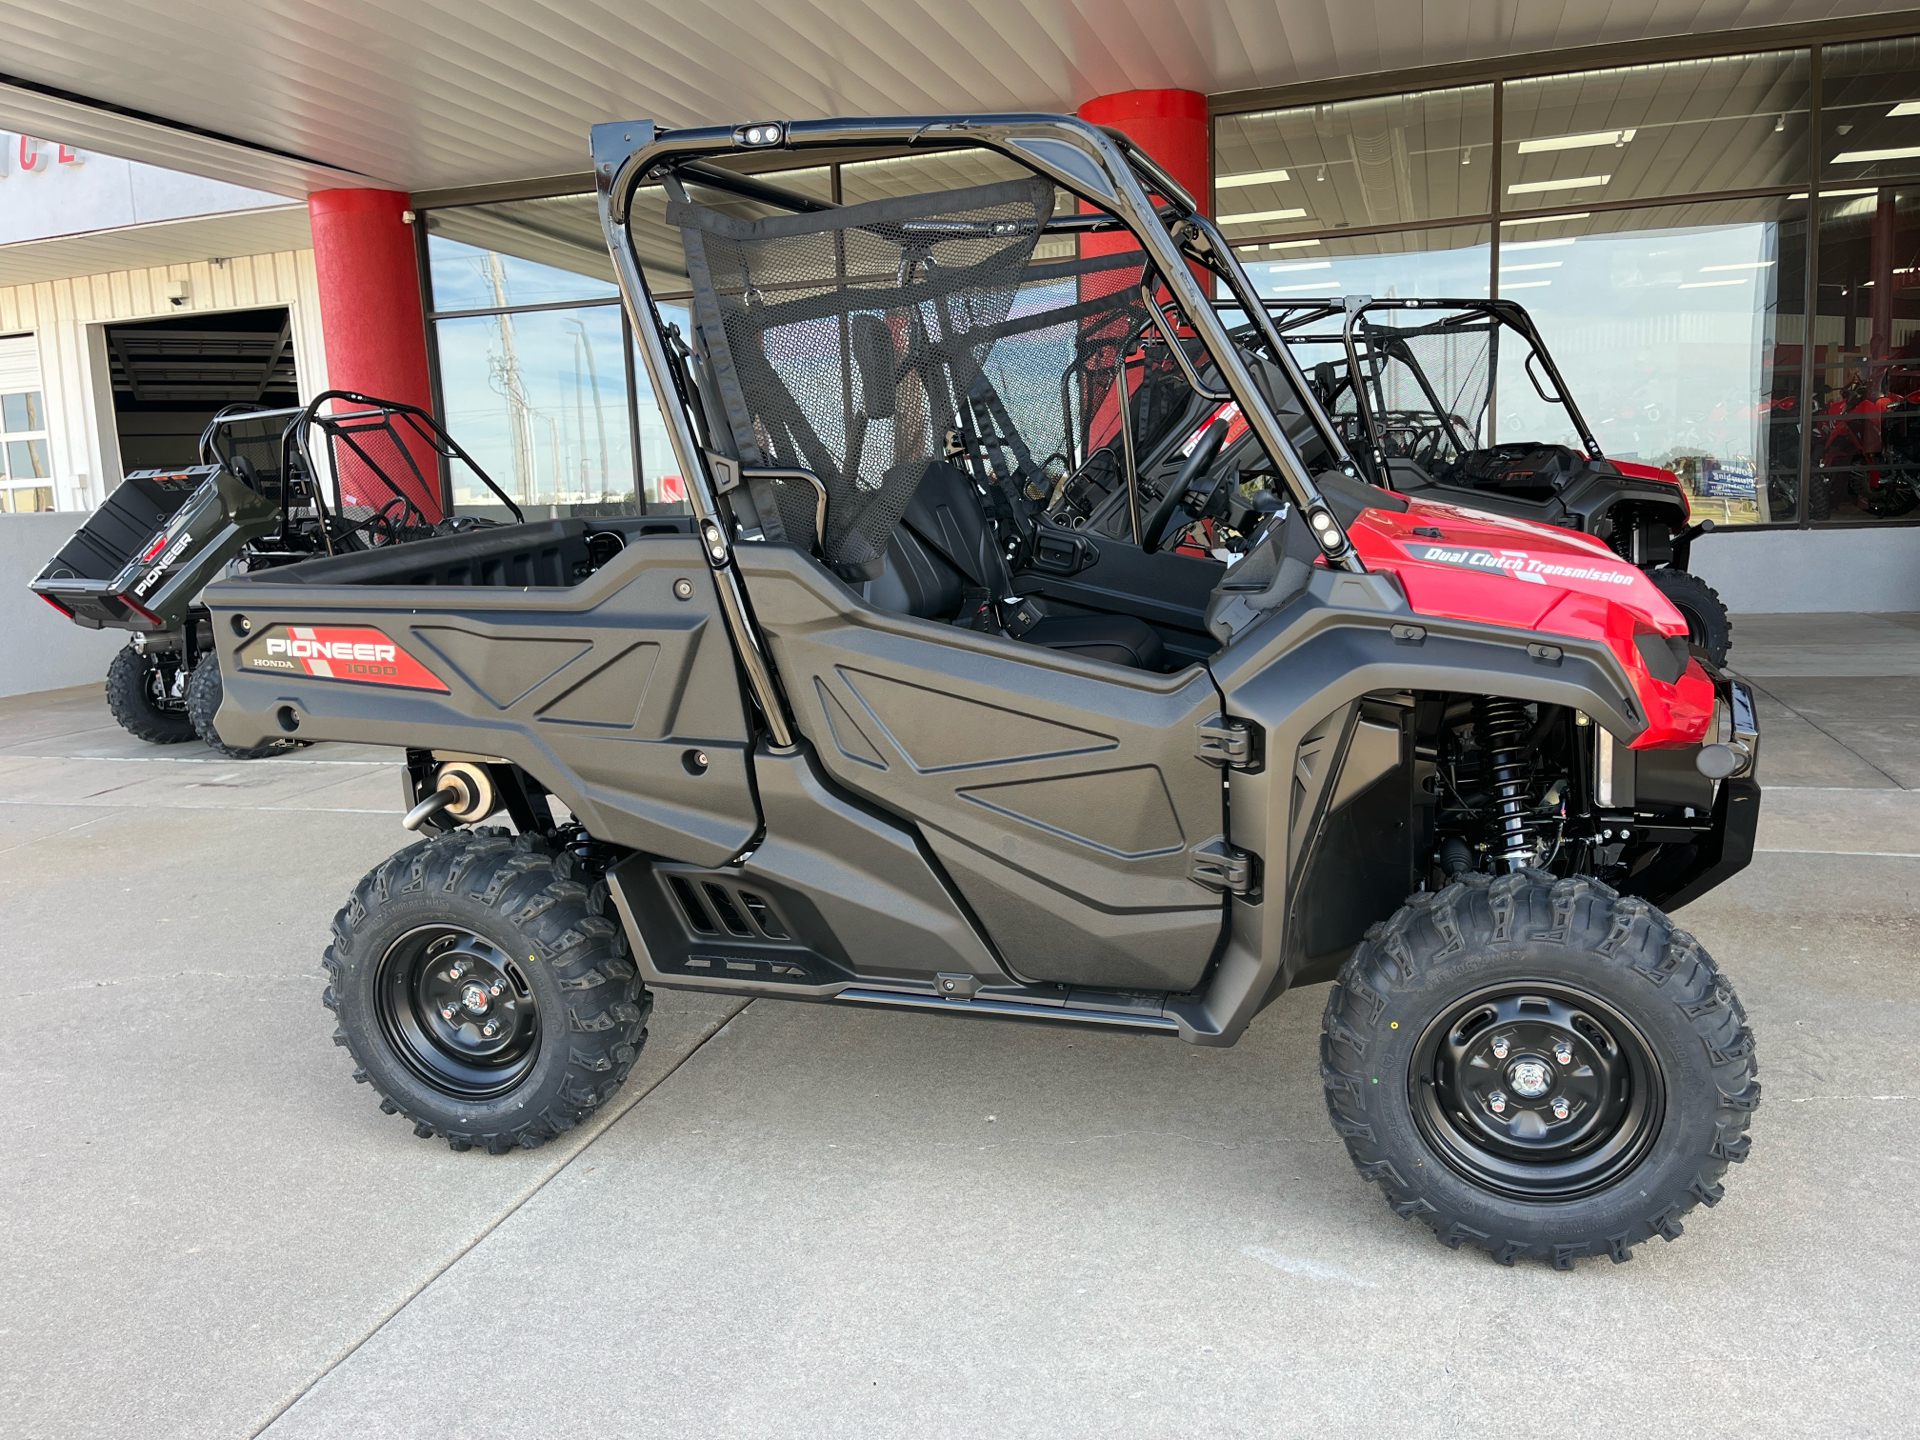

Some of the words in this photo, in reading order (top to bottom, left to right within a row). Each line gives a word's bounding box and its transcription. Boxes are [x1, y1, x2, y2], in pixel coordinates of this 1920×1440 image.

[133, 532, 193, 597] PIONEER
[1424, 547, 1464, 563] Dual
[1469, 552, 1524, 571] Clutch
[1528, 559, 1635, 586] Transmission
[266, 638, 396, 662] PIONEER
[253, 658, 294, 669] HONDA
[346, 663, 397, 676] 1000
